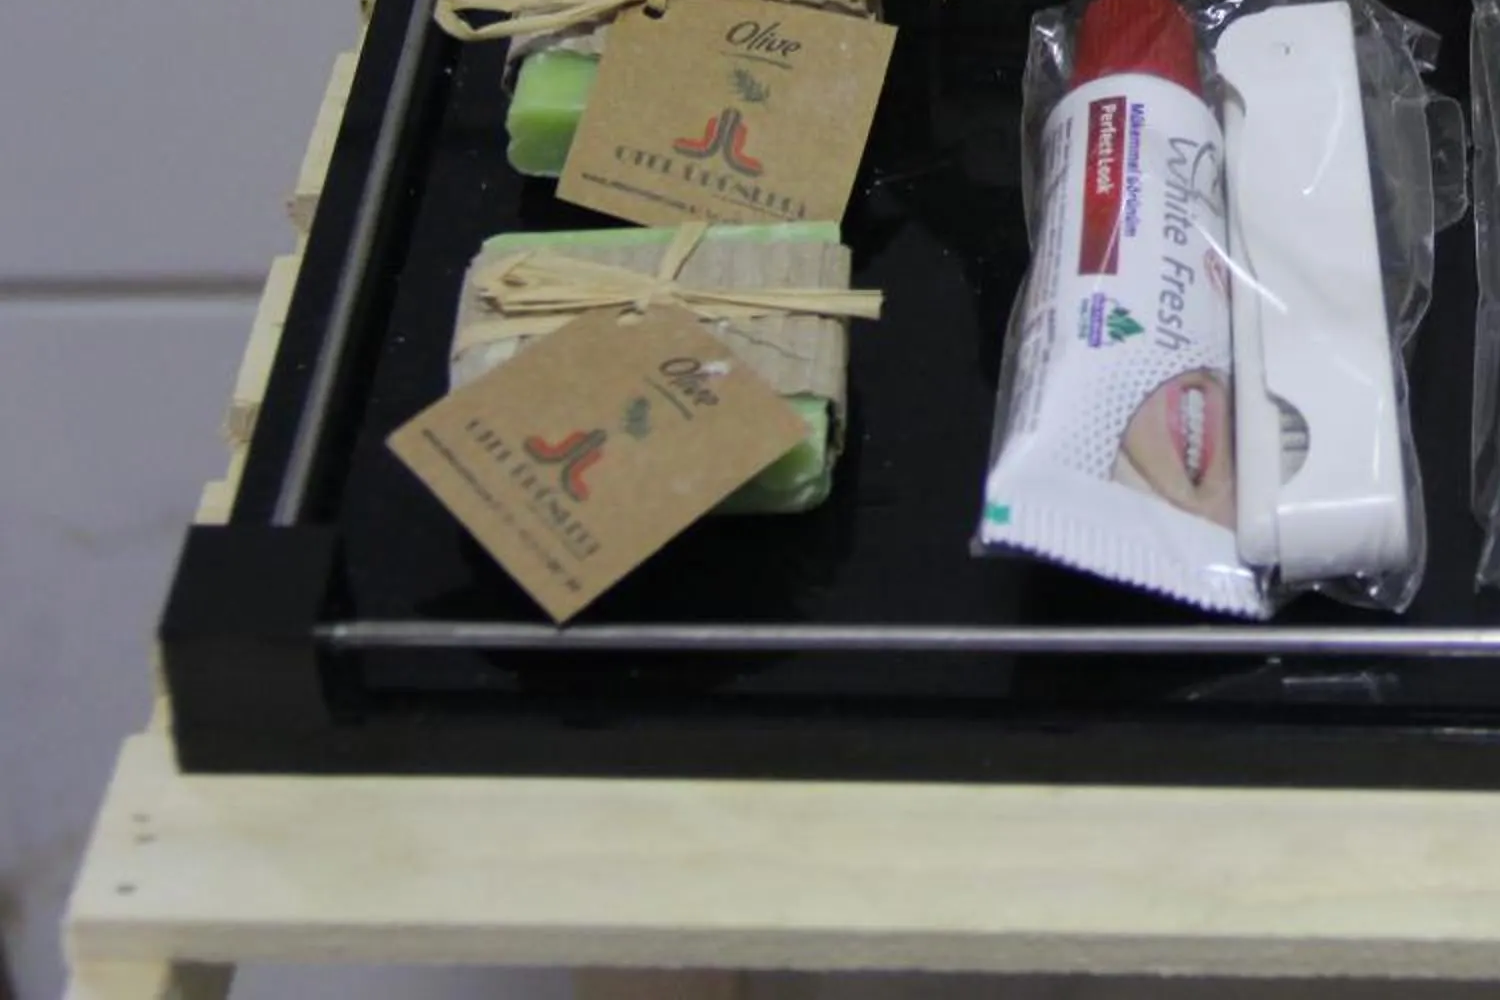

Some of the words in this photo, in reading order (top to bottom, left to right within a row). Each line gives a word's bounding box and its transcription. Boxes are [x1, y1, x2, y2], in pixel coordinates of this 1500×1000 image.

[725, 20, 801, 57] Olive
[1096, 103, 1117, 157] Perfect
[1095, 158, 1115, 194] Look
[1164, 137, 1200, 247] White
[1155, 255, 1195, 352] Fresh
